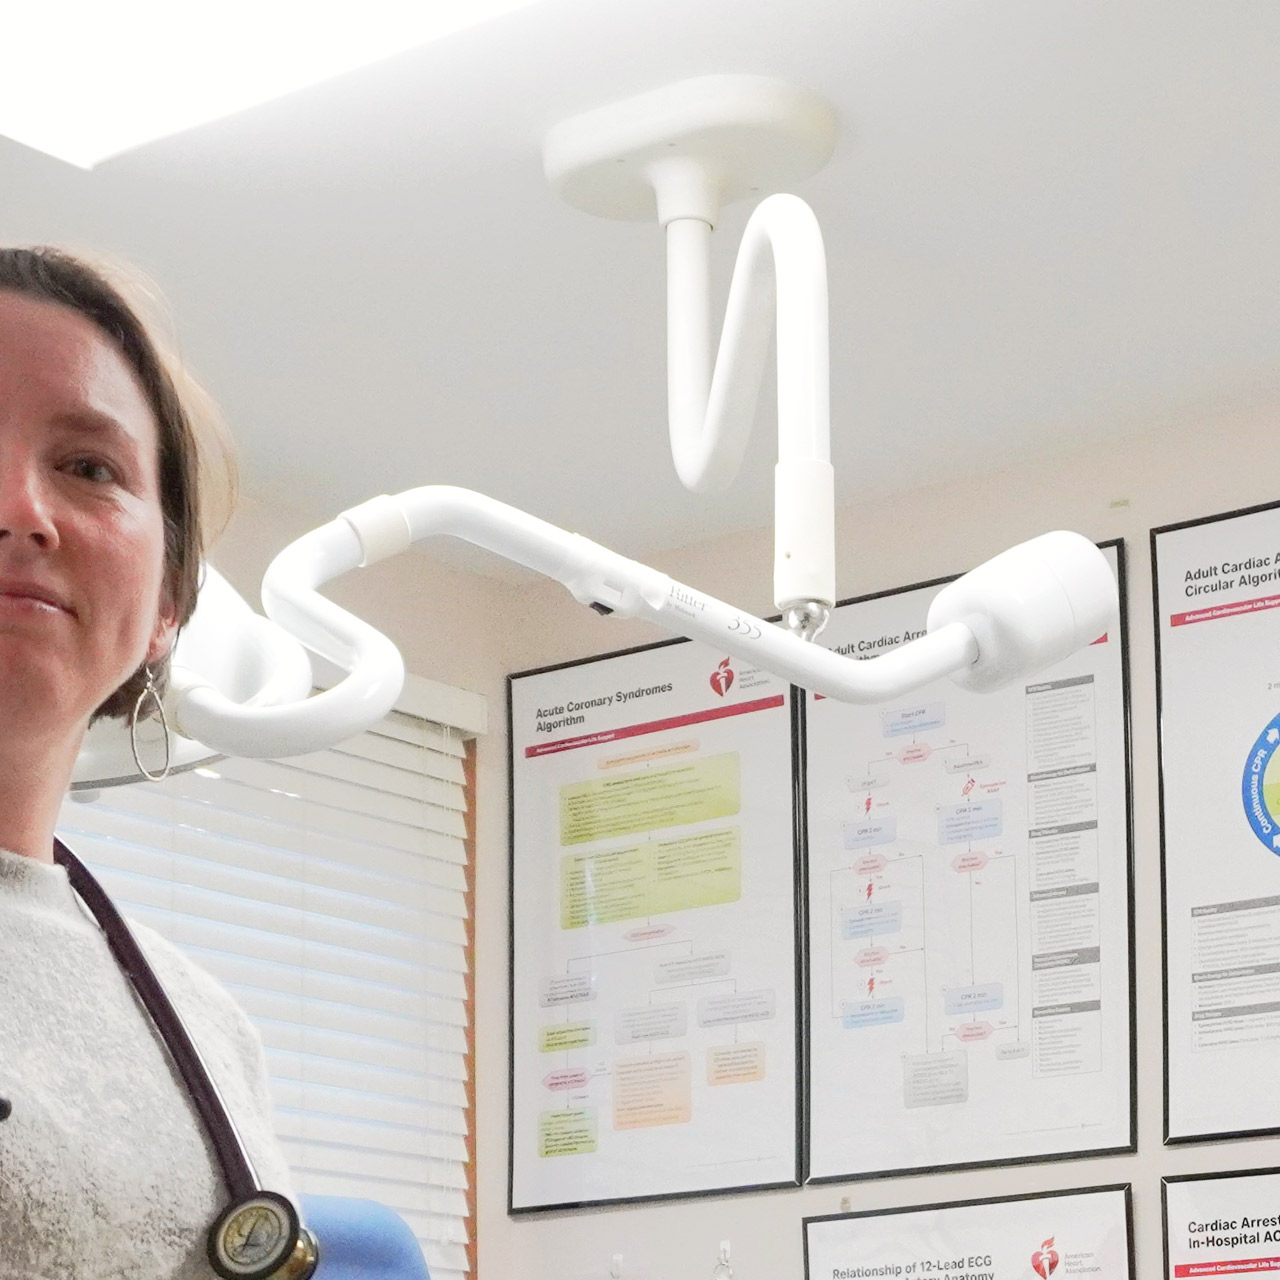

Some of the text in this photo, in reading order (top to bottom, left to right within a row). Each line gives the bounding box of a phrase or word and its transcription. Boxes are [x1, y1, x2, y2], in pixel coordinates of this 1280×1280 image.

[1185, 565, 1218, 582] Adult
[1222, 557, 1271, 575] Cardiac
[1186, 579, 1234, 597] Circular
[728, 616, 761, 639] 355
[858, 635, 899, 651] Cardiac
[903, 630, 927, 642] Arre
[536, 683, 673, 719] Acute Coronary Syndromes
[537, 713, 584, 732] Algorithm
[1251, 749, 1272, 833] Continuous CPR
[1189, 1220, 1237, 1233] Cardiac
[1189, 1232, 1259, 1249] In-Hospital
[833, 1255, 992, 1279] Relationship of 12-Lead ECG
